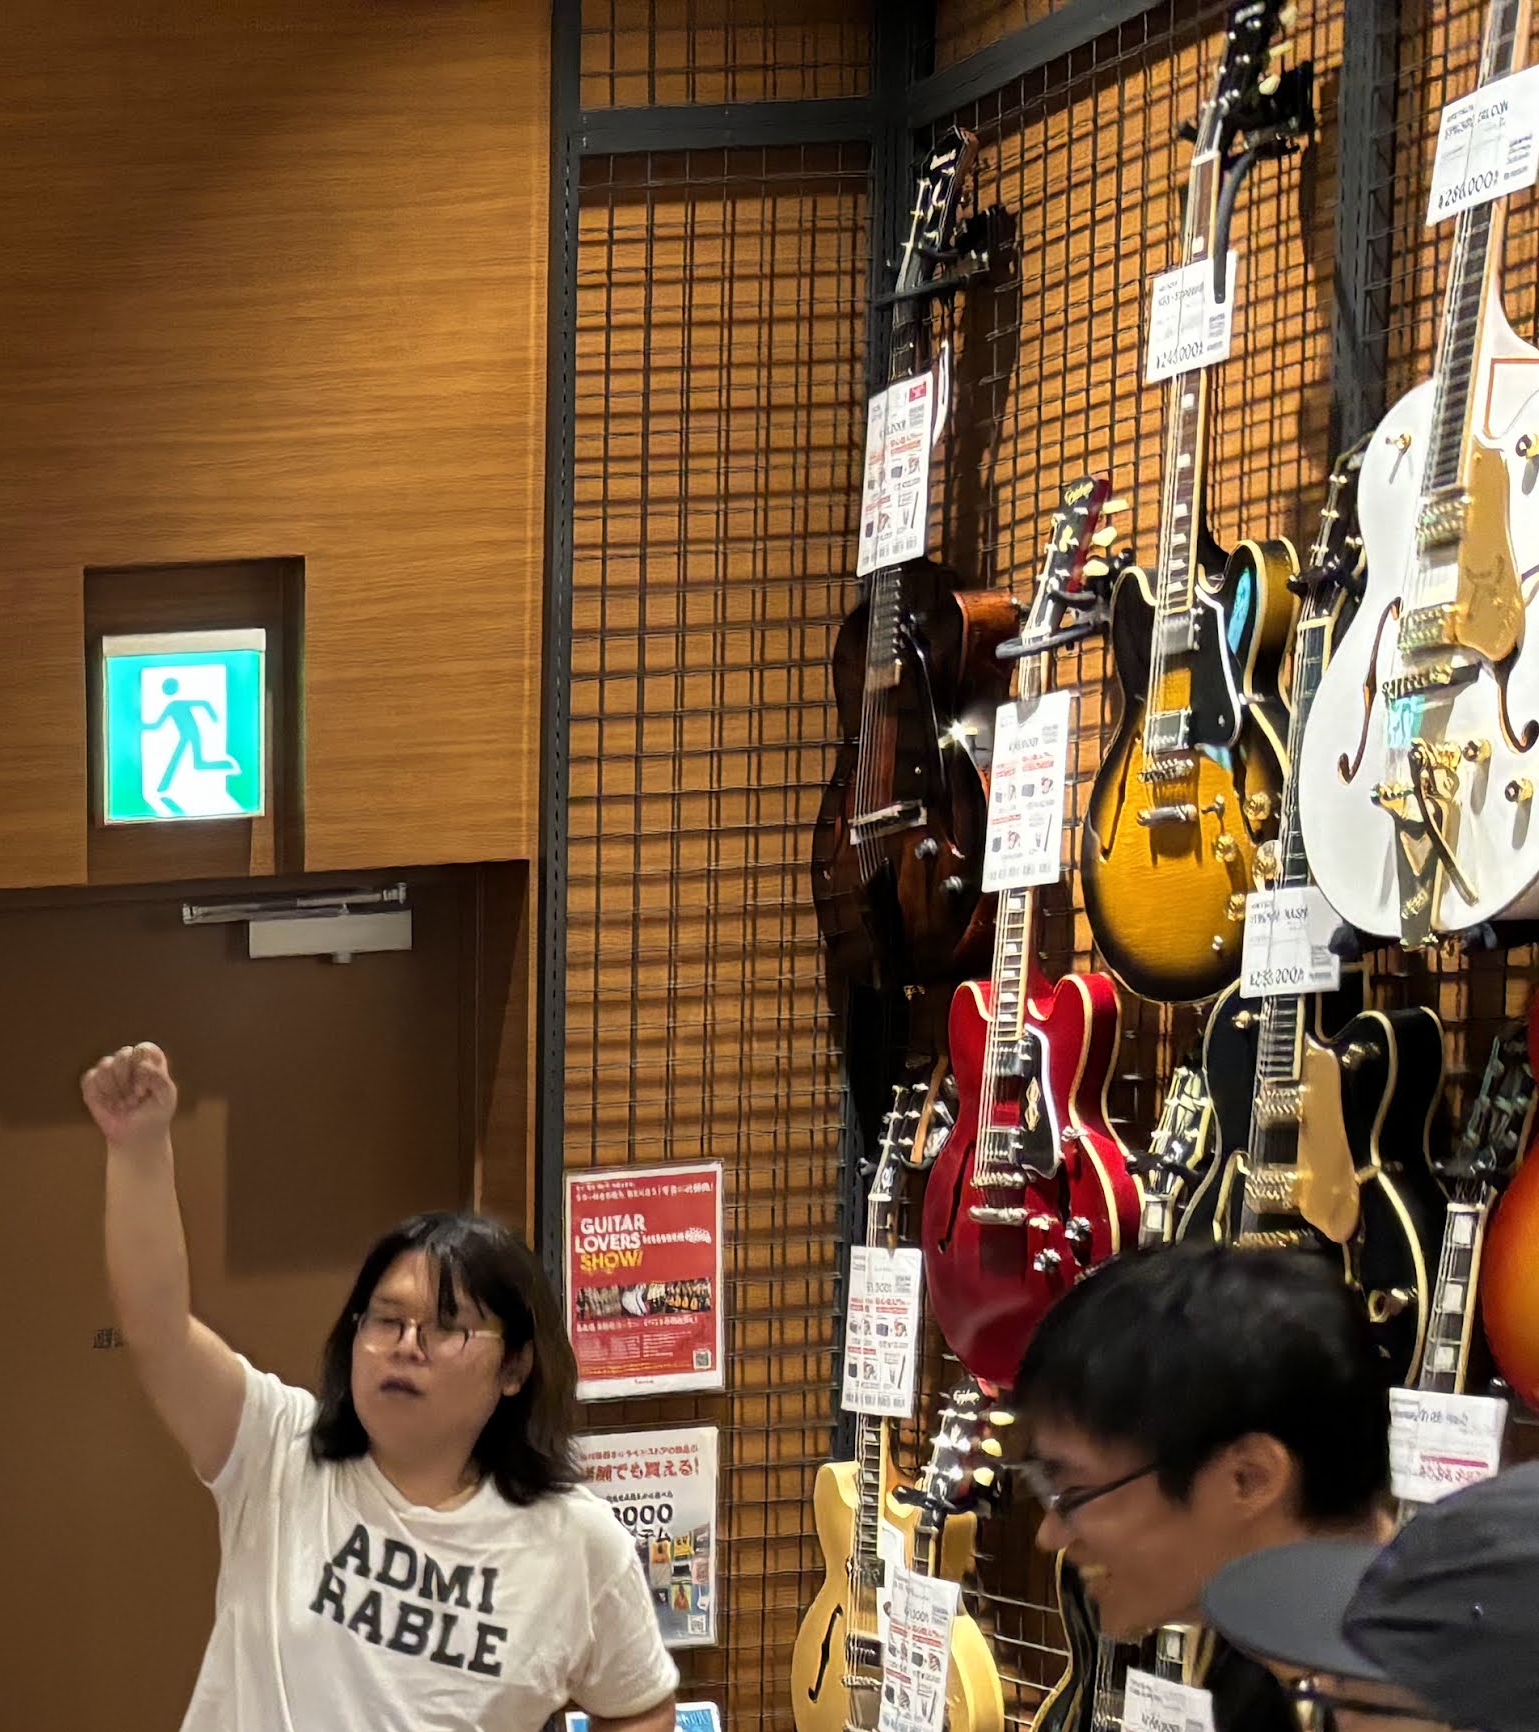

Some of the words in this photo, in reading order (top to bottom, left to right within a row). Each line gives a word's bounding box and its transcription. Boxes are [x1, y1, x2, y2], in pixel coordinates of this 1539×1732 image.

[580, 1214, 647, 1235] GUITAR
[332, 1524, 498, 1615] ADMI
[309, 1562, 508, 1677] RABLE
